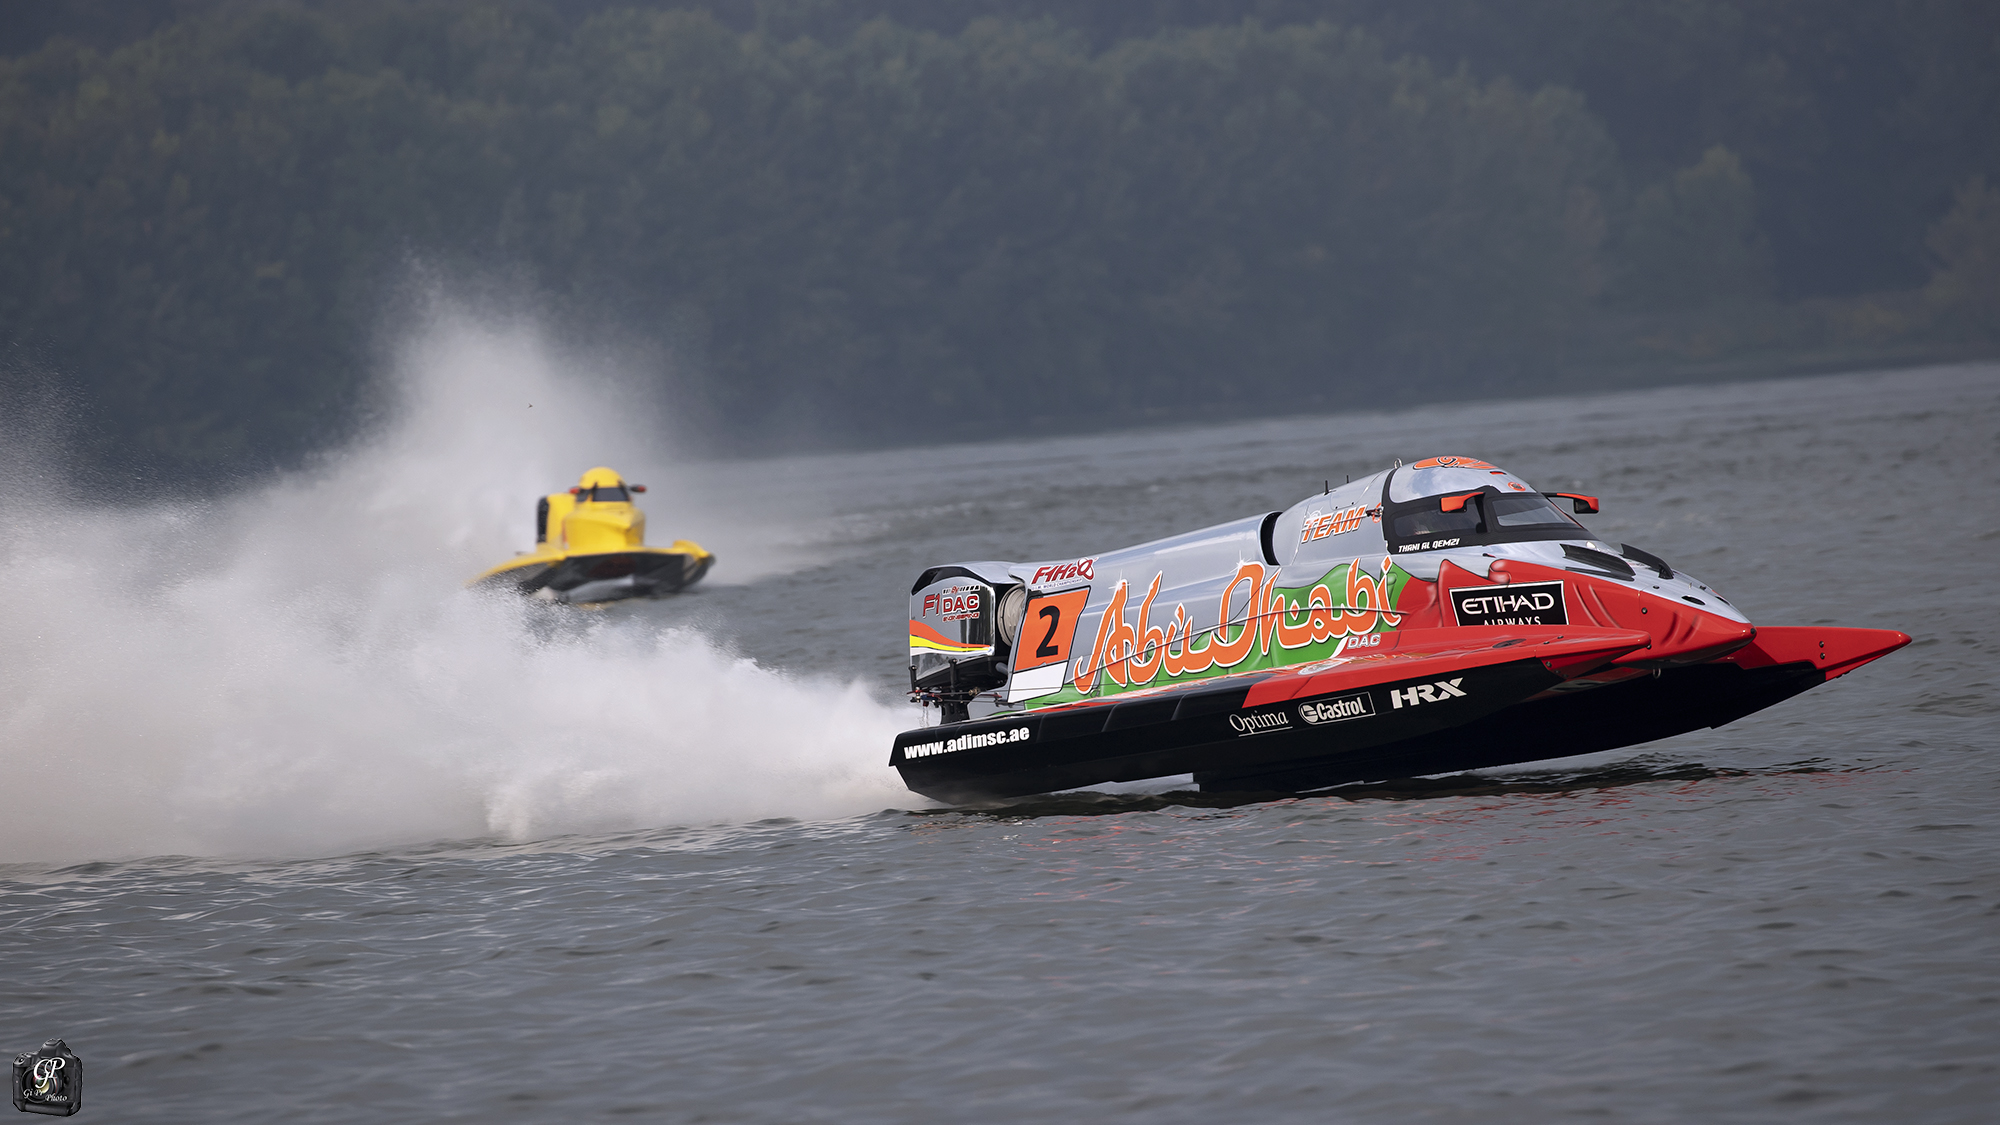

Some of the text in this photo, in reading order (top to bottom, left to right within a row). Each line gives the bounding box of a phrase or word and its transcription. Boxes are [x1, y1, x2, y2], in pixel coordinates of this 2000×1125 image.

[1301, 505, 1367, 543] TEAM
[1399, 538, 1460, 553] THANI AL QEMZI
[923, 593, 979, 617] F1 DAC
[1462, 592, 1555, 614] ETIHAD
[1036, 605, 1061, 658] 2
[1347, 633, 1381, 649] DAC
[1390, 677, 1467, 709] HRX
[1316, 697, 1366, 721] Castrol
[1229, 710, 1289, 735] Optima
[904, 727, 1030, 760] www.adimsc.ae
